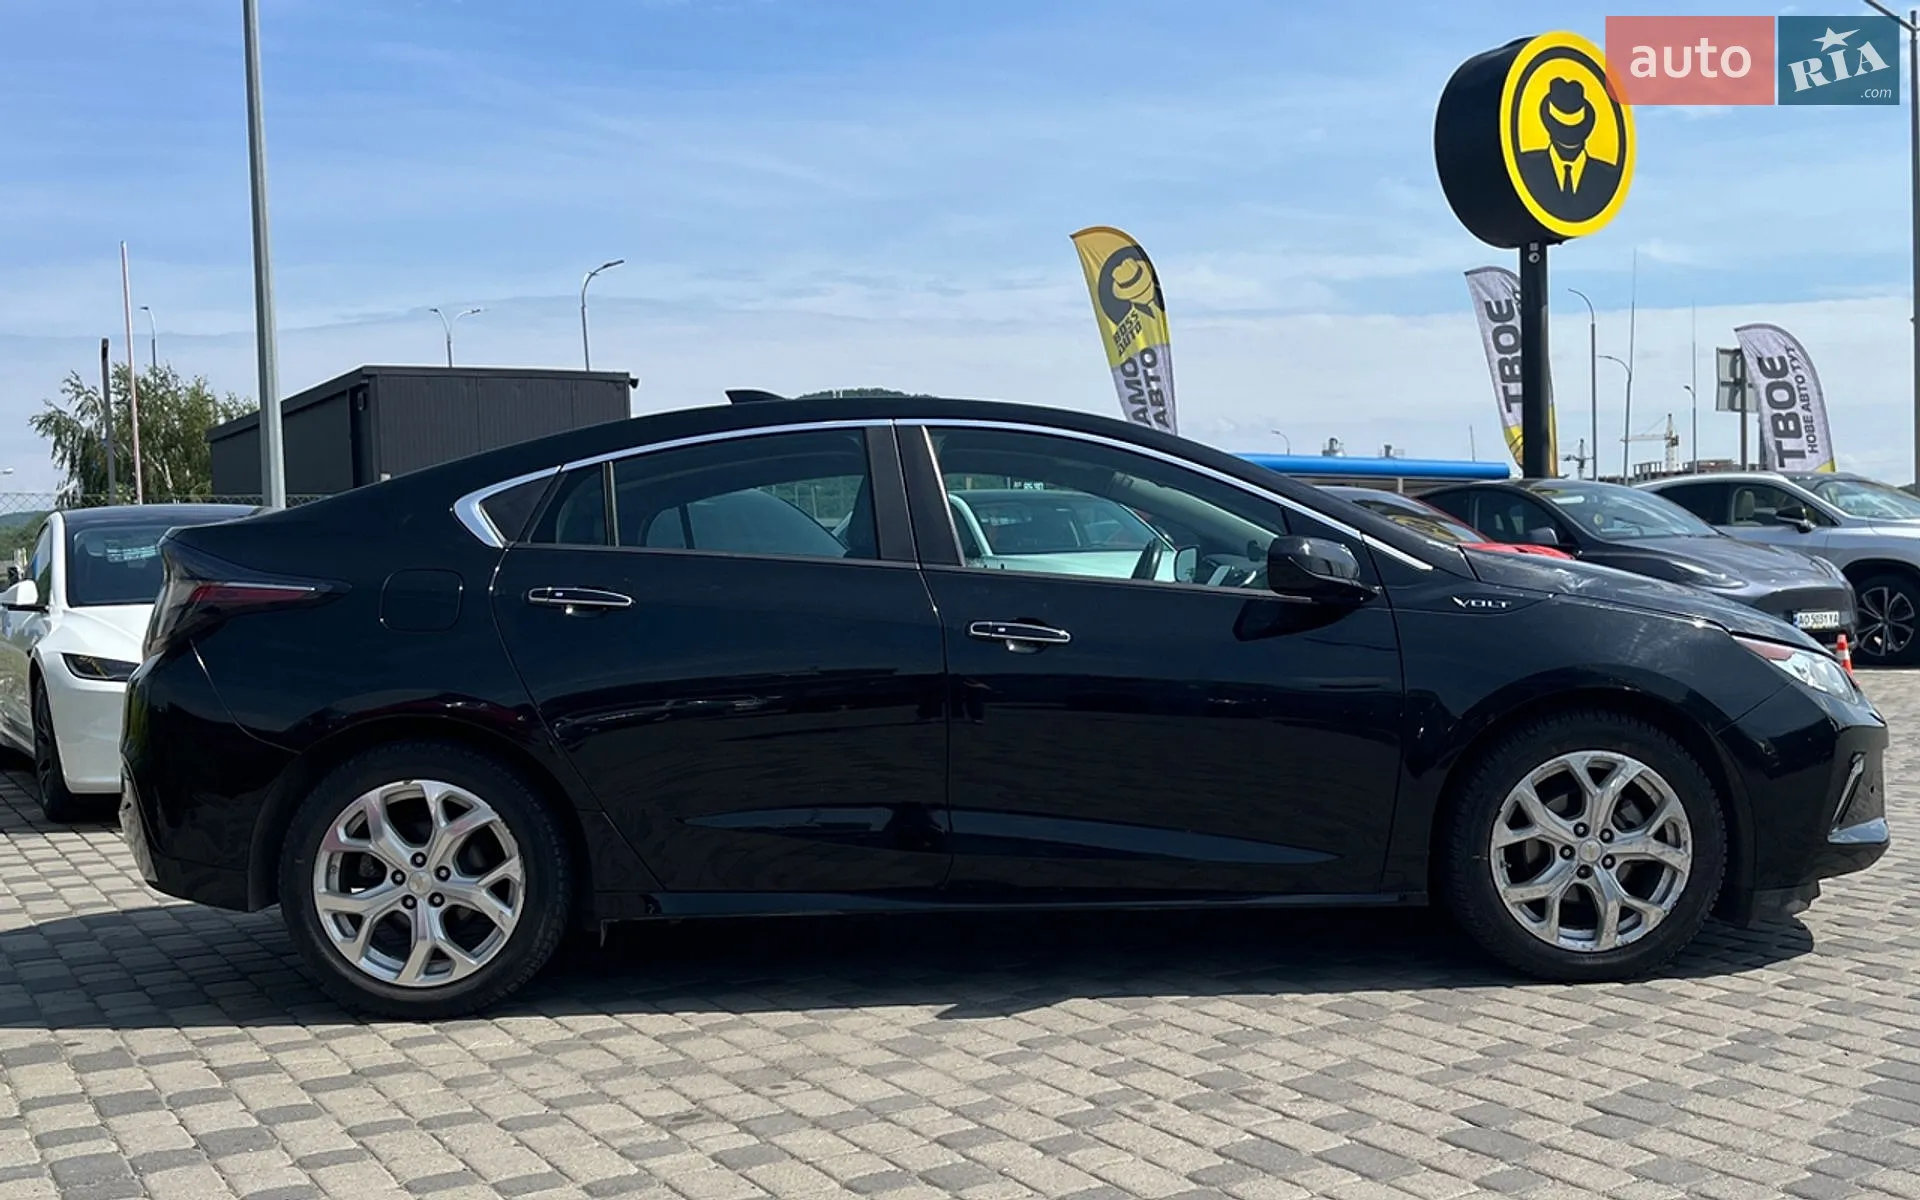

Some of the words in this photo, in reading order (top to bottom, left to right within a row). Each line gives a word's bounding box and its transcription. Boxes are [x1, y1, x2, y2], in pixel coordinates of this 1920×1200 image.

[1112, 309, 1140, 346] BOSS
[1794, 375, 1812, 413] АВТО
[1803, 415, 1819, 454] НОВЕ
[1451, 596, 1512, 608] VOLT
